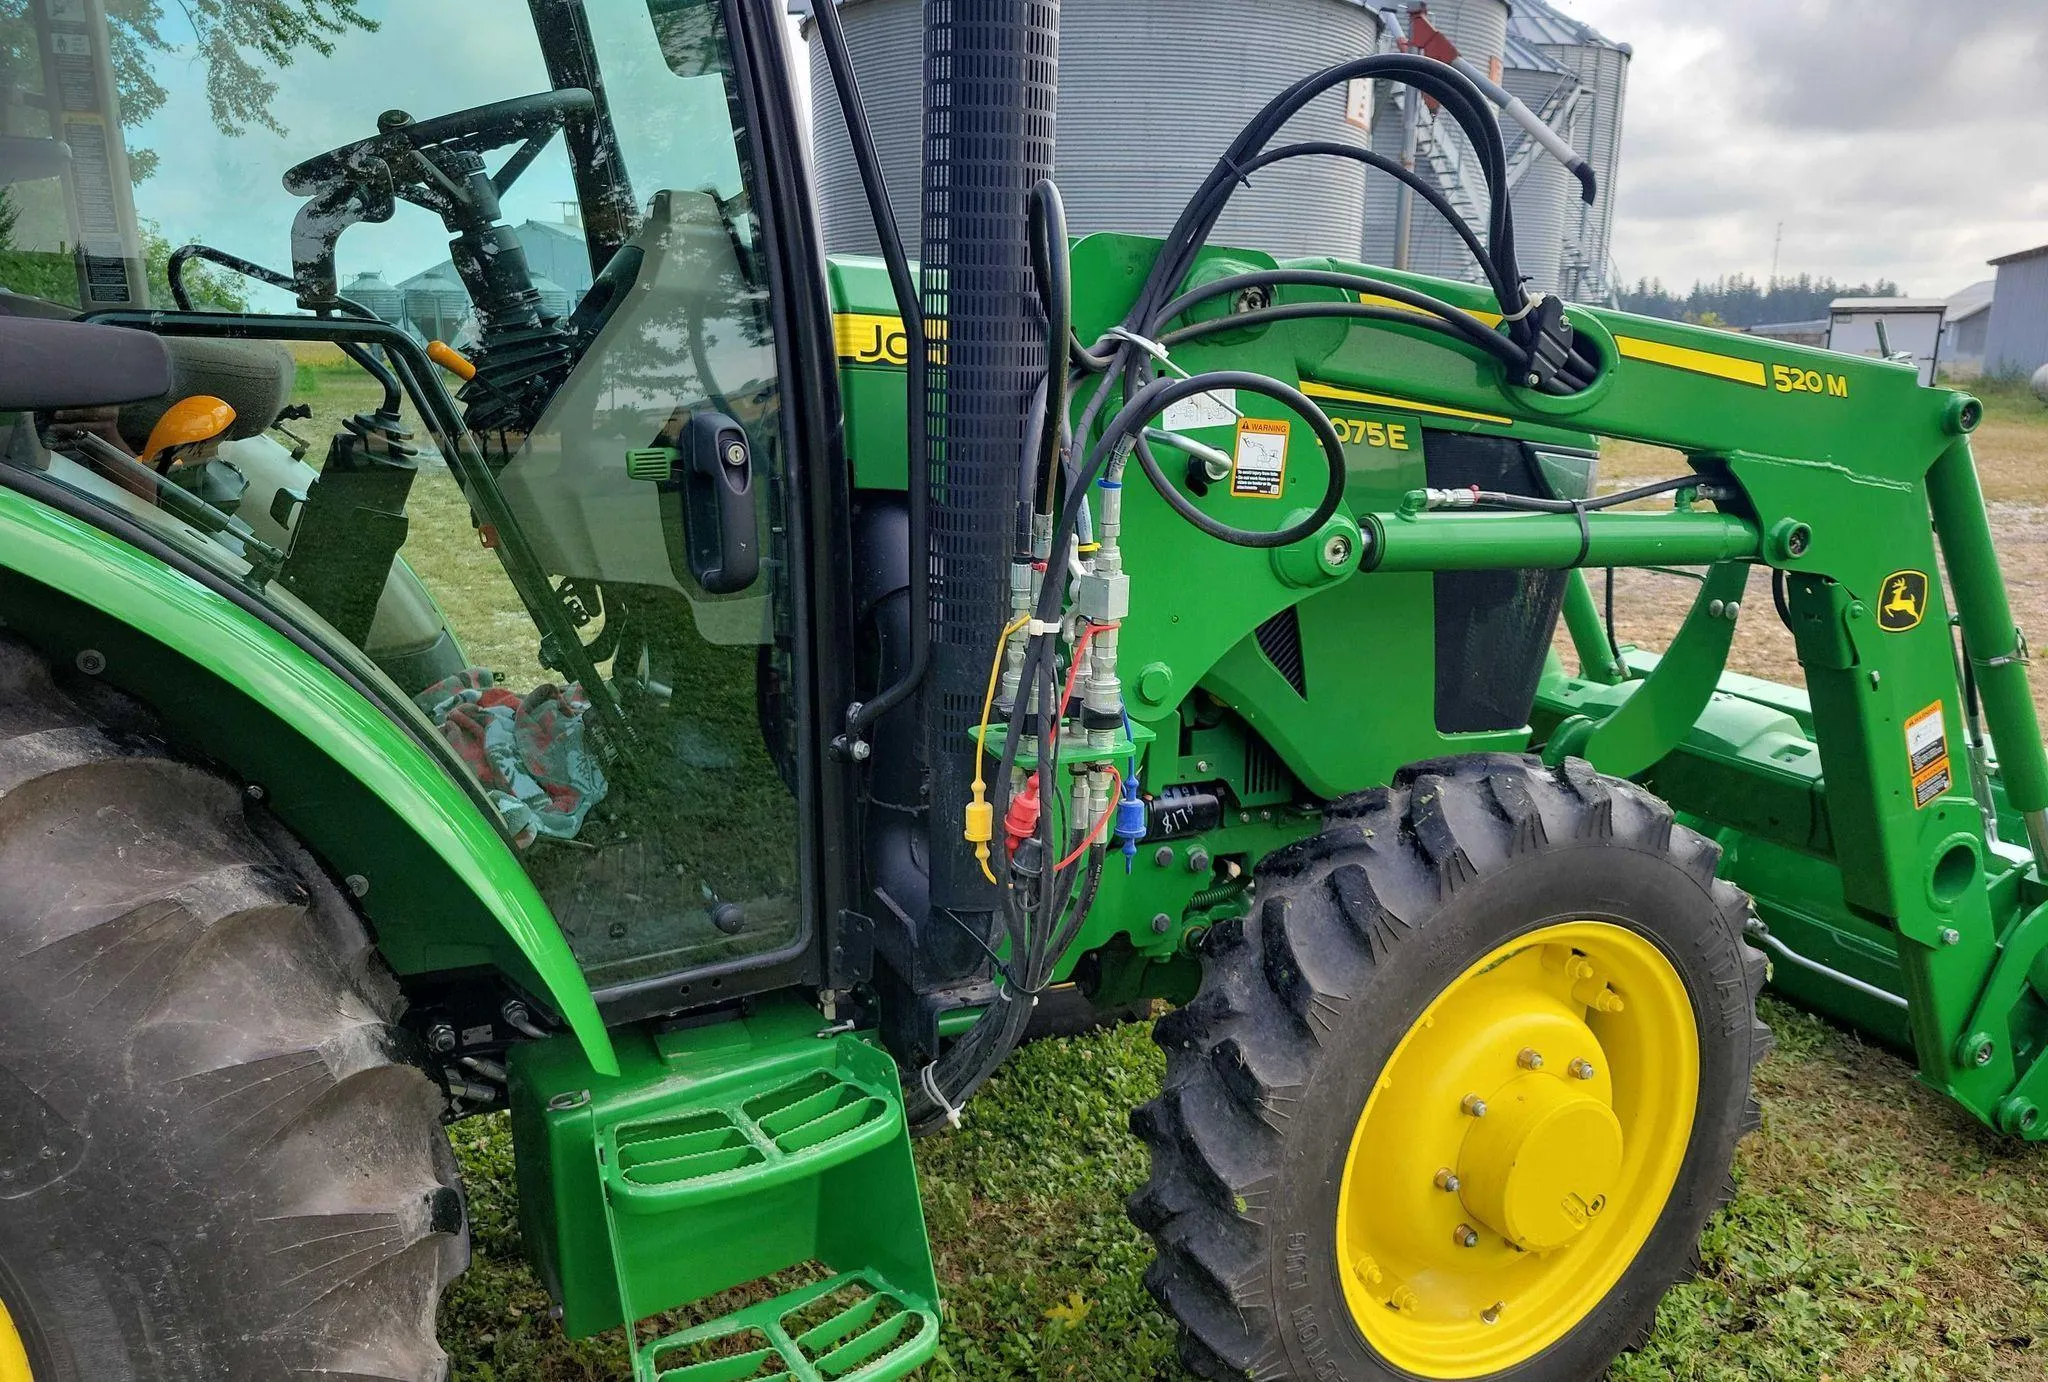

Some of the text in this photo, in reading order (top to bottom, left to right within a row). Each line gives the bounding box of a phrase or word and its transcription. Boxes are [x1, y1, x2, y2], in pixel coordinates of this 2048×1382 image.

[1773, 364, 1848, 398] 520 M
[1251, 423, 1287, 433] WARNING
[1316, 417, 1409, 450] 075E
